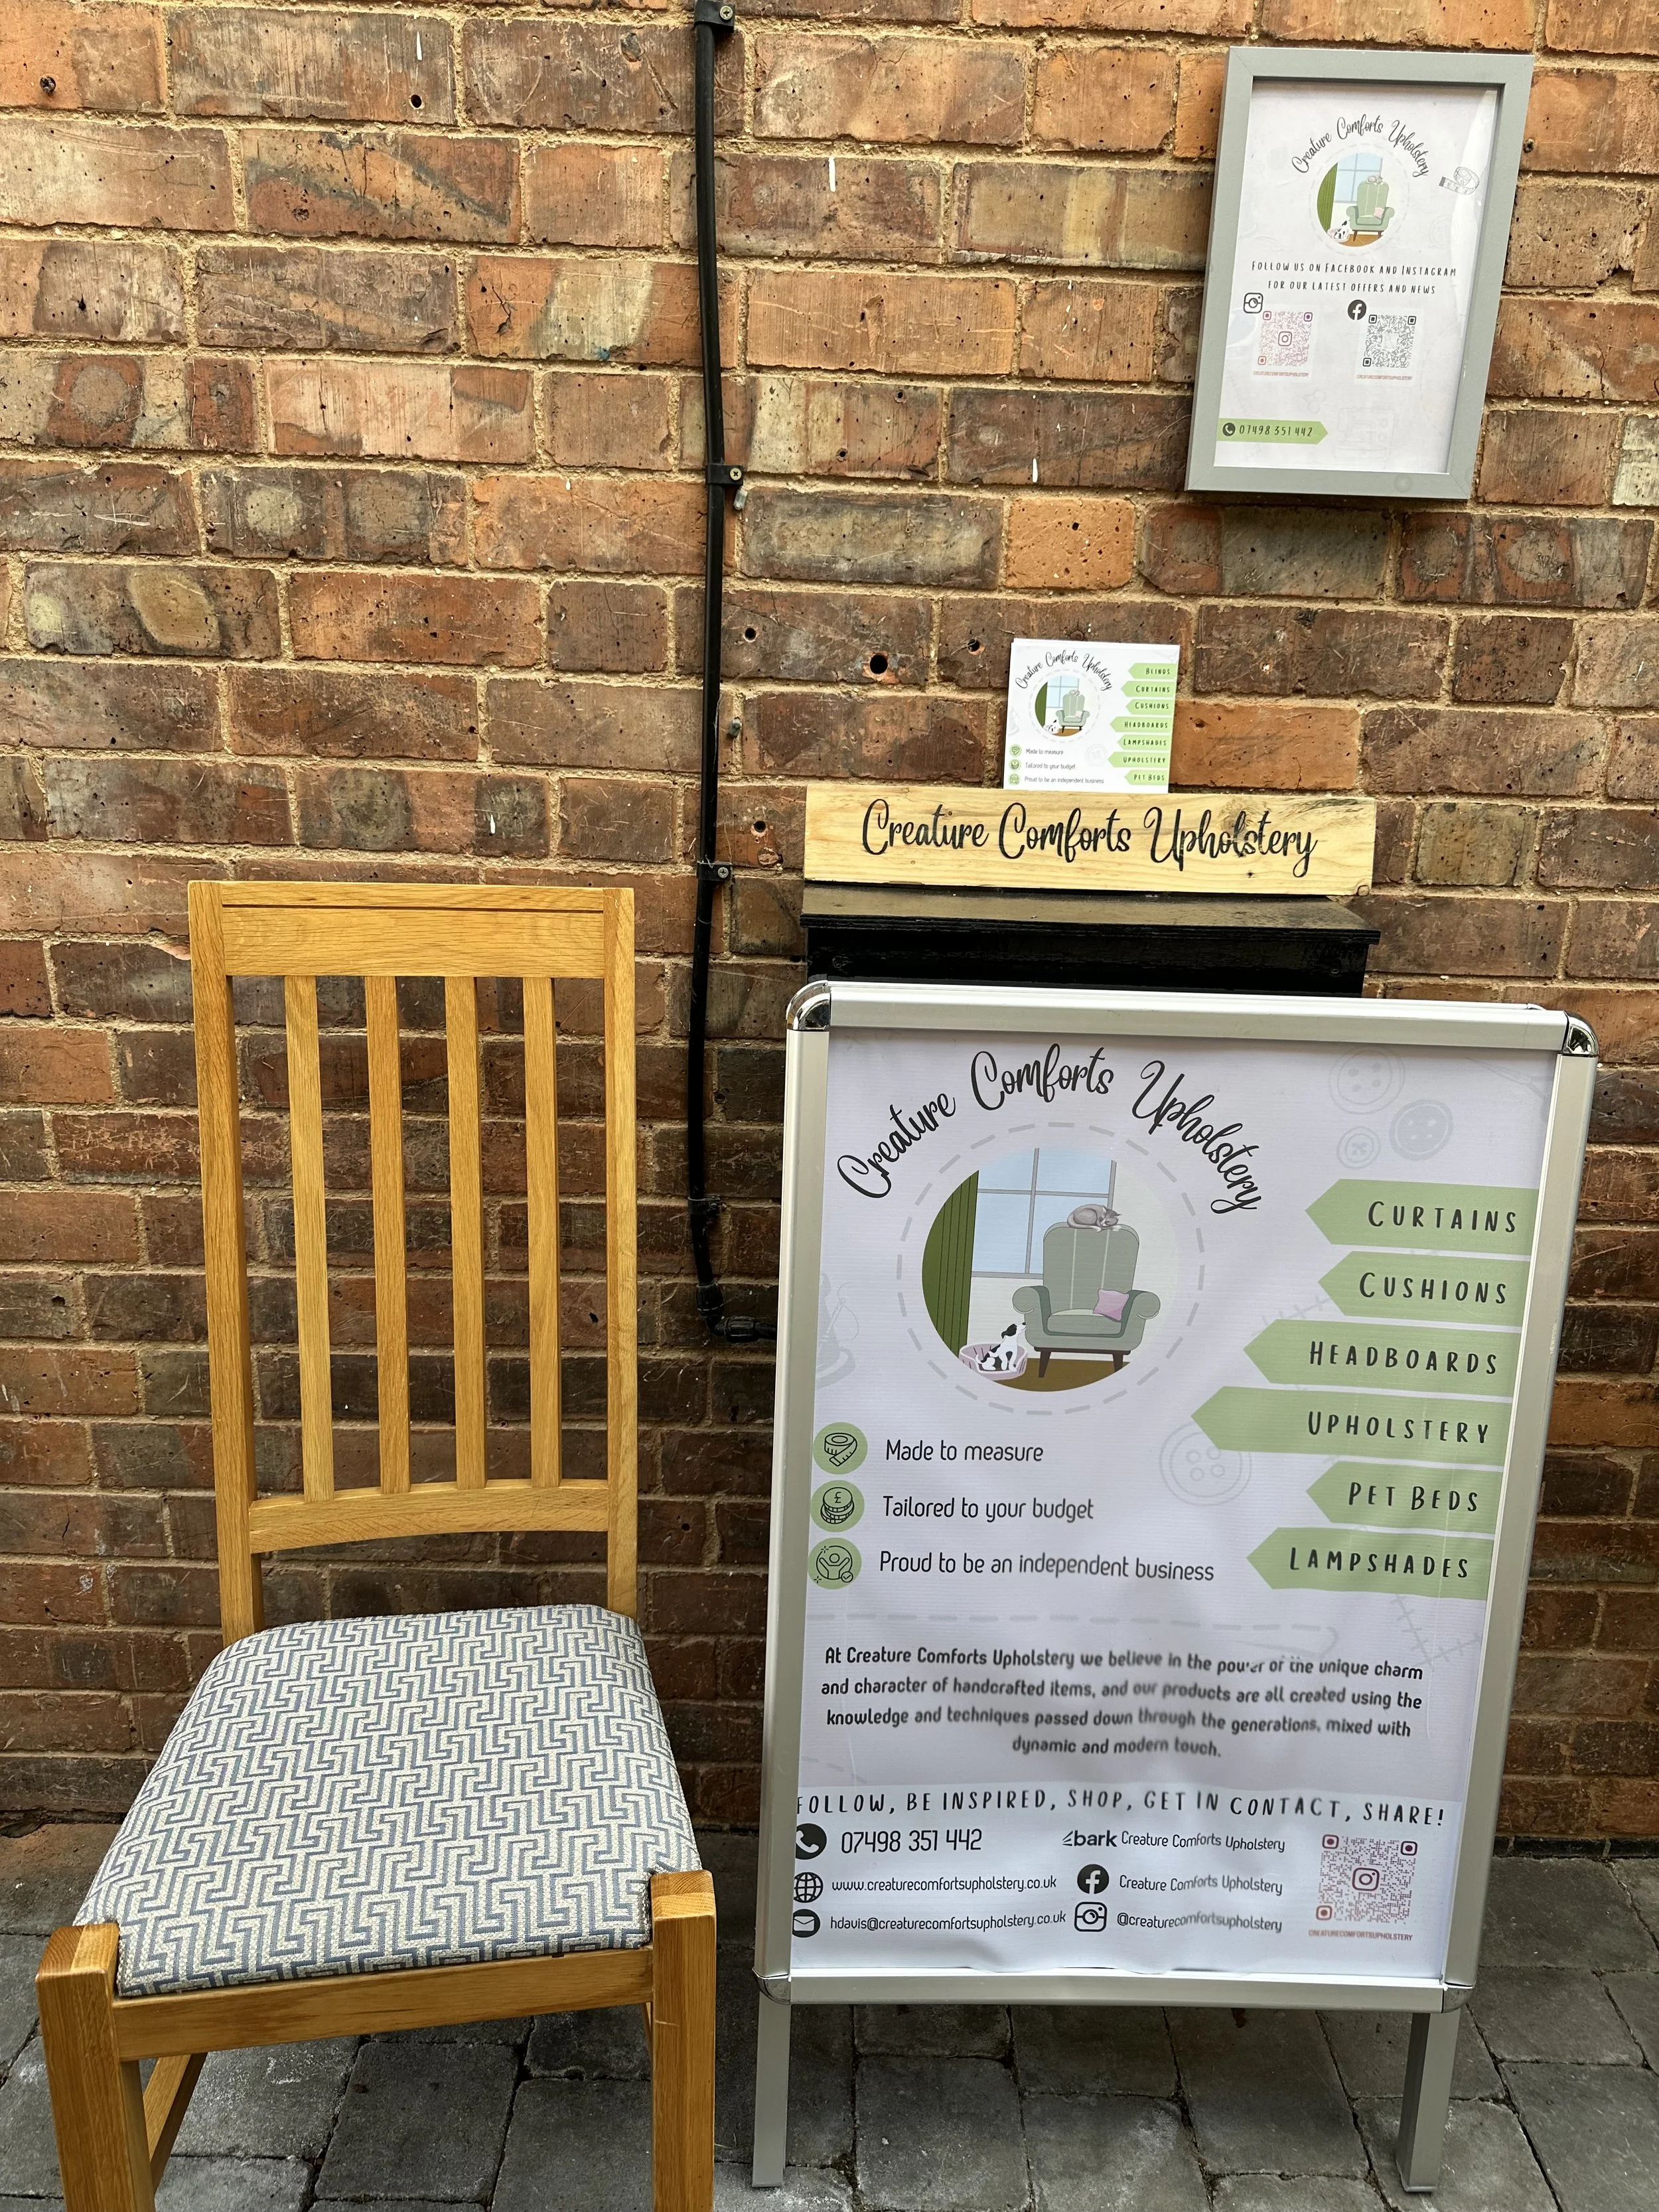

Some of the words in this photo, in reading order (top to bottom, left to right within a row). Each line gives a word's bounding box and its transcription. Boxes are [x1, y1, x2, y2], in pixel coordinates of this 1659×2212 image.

[1291, 131, 1332, 173] Creature
[1337, 114, 1383, 139] Comforts
[1388, 120, 1429, 177] Upholstery
[1252, 261, 1289, 270] FOLLOW
[1325, 263, 1374, 273] FACEBOOK
[1402, 265, 1455, 276] INSTAGRAM
[1313, 282, 1345, 291] LATEST
[1351, 283, 1384, 292] OFFERS
[1240, 425, 1270, 435] 07498
[1275, 426, 1291, 435] 351
[1295, 427, 1312, 436] 442
[1015, 662, 1043, 689] Creature
[1046, 650, 1078, 666] Comforts
[1082, 654, 1112, 691] Upholstery
[863, 799, 989, 855] Creature
[999, 802, 1131, 863] Comforts
[1144, 804, 1320, 878] Upholstery
[837, 1092, 956, 1199] Creature
[971, 1043, 1114, 1110] Comforts
[1132, 1061, 1262, 1214] Upholstery
[1368, 1201, 1516, 1232] CURTAINS
[1360, 1272, 1506, 1303] CUSHIONS
[1311, 1341, 1496, 1374] HEADBOARDS
[1309, 1412, 1488, 1443] UPHOLSTERY
[887, 1439, 933, 1461] Made
[941, 1440, 956, 1460] to
[965, 1446, 1043, 1461] measure
[883, 1496, 954, 1517] Tailored
[962, 1497, 978, 1518] to
[986, 1503, 1026, 1522] your
[1033, 1498, 1093, 1523] budget
[1349, 1482, 1395, 1506] PET
[1411, 1487, 1477, 1511] BEDS
[881, 1551, 932, 1572] Proud
[940, 1552, 956, 1573] to
[964, 1553, 984, 1573] be
[991, 1559, 1012, 1573] an
[1020, 1552, 1129, 1578] independent
[1136, 1558, 1214, 1580] business
[1290, 1548, 1467, 1578] LAMPSHADES
[826, 1647, 841, 1664] At
[847, 1647, 911, 1662] Creature
[918, 1647, 987, 1664] Comforts
[993, 1649, 1074, 1669] Upholstery
[1081, 1655, 1102, 1666] we
[1109, 1651, 1162, 1666] believe
[1169, 1653, 1181, 1667] in
[1187, 1654, 1212, 1670] the
[1269, 1655, 1283, 1672] of
[1290, 1657, 1313, 1673] the
[1319, 1659, 1368, 1677] unique
[1375, 1660, 1422, 1680] charm
[822, 1678, 848, 1694] and
[855, 1677, 927, 1694] character
[933, 1677, 948, 1692] of
[954, 1678, 1045, 1696] handcrafted
[1050, 1680, 1095, 1698] items,
[1102, 1680, 1128, 1696] and
[1133, 1684, 1157, 1695] our
[1163, 1683, 1230, 1701] products
[1236, 1692, 1260, 1702] are
[1265, 1686, 1283, 1702] all
[1290, 1686, 1346, 1702] created
[1352, 1692, 1391, 1710] using
[1398, 1692, 1421, 1709] the
[828, 1708, 908, 1728] knowledge
[915, 1706, 941, 1722] and
[948, 1706, 1029, 1726] techniques
[1035, 1711, 1088, 1727] passed
[1094, 1710, 1132, 1726] down
[1139, 1708, 1195, 1728] through
[1202, 1712, 1226, 1729] the
[1232, 1716, 1320, 1735] generations,
[1327, 1719, 1372, 1734] mixed
[1378, 1721, 1410, 1737] with
[1013, 1735, 1076, 1754] dynamic
[1082, 1739, 1108, 1753] and
[1114, 1737, 1168, 1753] modern
[1175, 1737, 1220, 1757] touch.
[797, 1794, 894, 1814] FOLLOW,
[907, 1793, 930, 1810] BE
[944, 1791, 1055, 1810] INSPIRED,
[1068, 1790, 1131, 1810] SHOP,
[1145, 1791, 1183, 1810] GET
[1197, 1792, 1218, 1810] IN
[1230, 1797, 1350, 1822] CONTACT,
[1364, 1803, 1443, 1826] SHARE!
[841, 1831, 901, 1853] 07498
[909, 1830, 938, 1851] 351
[946, 1829, 981, 1850] 442
[1074, 1830, 1117, 1847] bark
[1122, 1831, 1168, 1846] Creature
[1173, 1833, 1221, 1847] Comforts
[1226, 1836, 1285, 1852] Upholstery
[832, 1876, 1056, 1893] www.creaturecomfortsupholstery.co.uk
[1120, 1875, 1167, 1891] Creature
[1171, 1875, 1217, 1891] Comforts
[1222, 1876, 1282, 1896] Upholstery
[831, 1911, 1066, 1932] hdavis@creaturecomfortsupholstery.co.uk
[1118, 1913, 1281, 1933] @creaturecomfortsupholstery
[1309, 1930, 1413, 1941] CREATURECOMFORTSUPHOLSTERY
